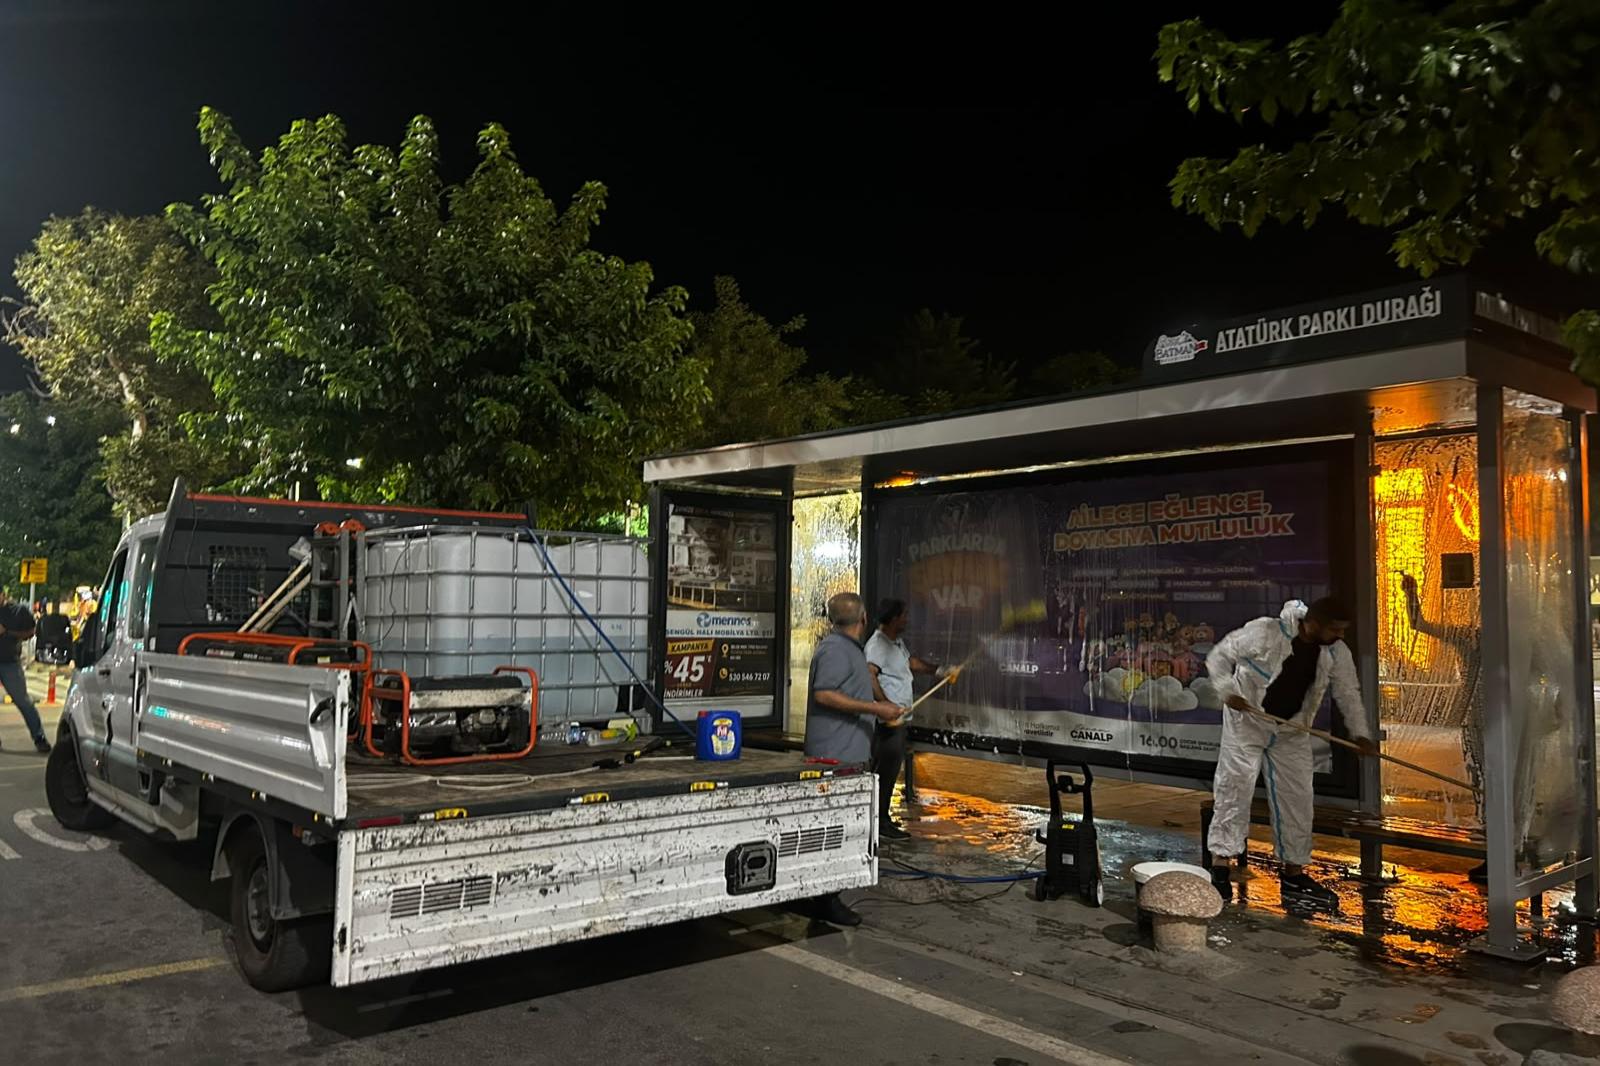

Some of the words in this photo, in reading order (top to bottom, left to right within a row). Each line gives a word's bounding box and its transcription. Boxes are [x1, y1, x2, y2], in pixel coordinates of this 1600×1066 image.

[1215, 317, 1294, 354] ATATÜRK
[1298, 305, 1357, 337] PARKI
[1361, 285, 1441, 328] DURAĞI
[1067, 502, 1146, 530] AİLECE
[1148, 490, 1272, 521] EĞLENCE,
[1157, 512, 1295, 545] MUTLULUK
[930, 585, 985, 609] VAR
[671, 642, 709, 652] KAMPANYA
[999, 663, 1040, 675] CANALP
[663, 687, 704, 698] İNDİRİMLER
[1070, 730, 1114, 742] CANALP
